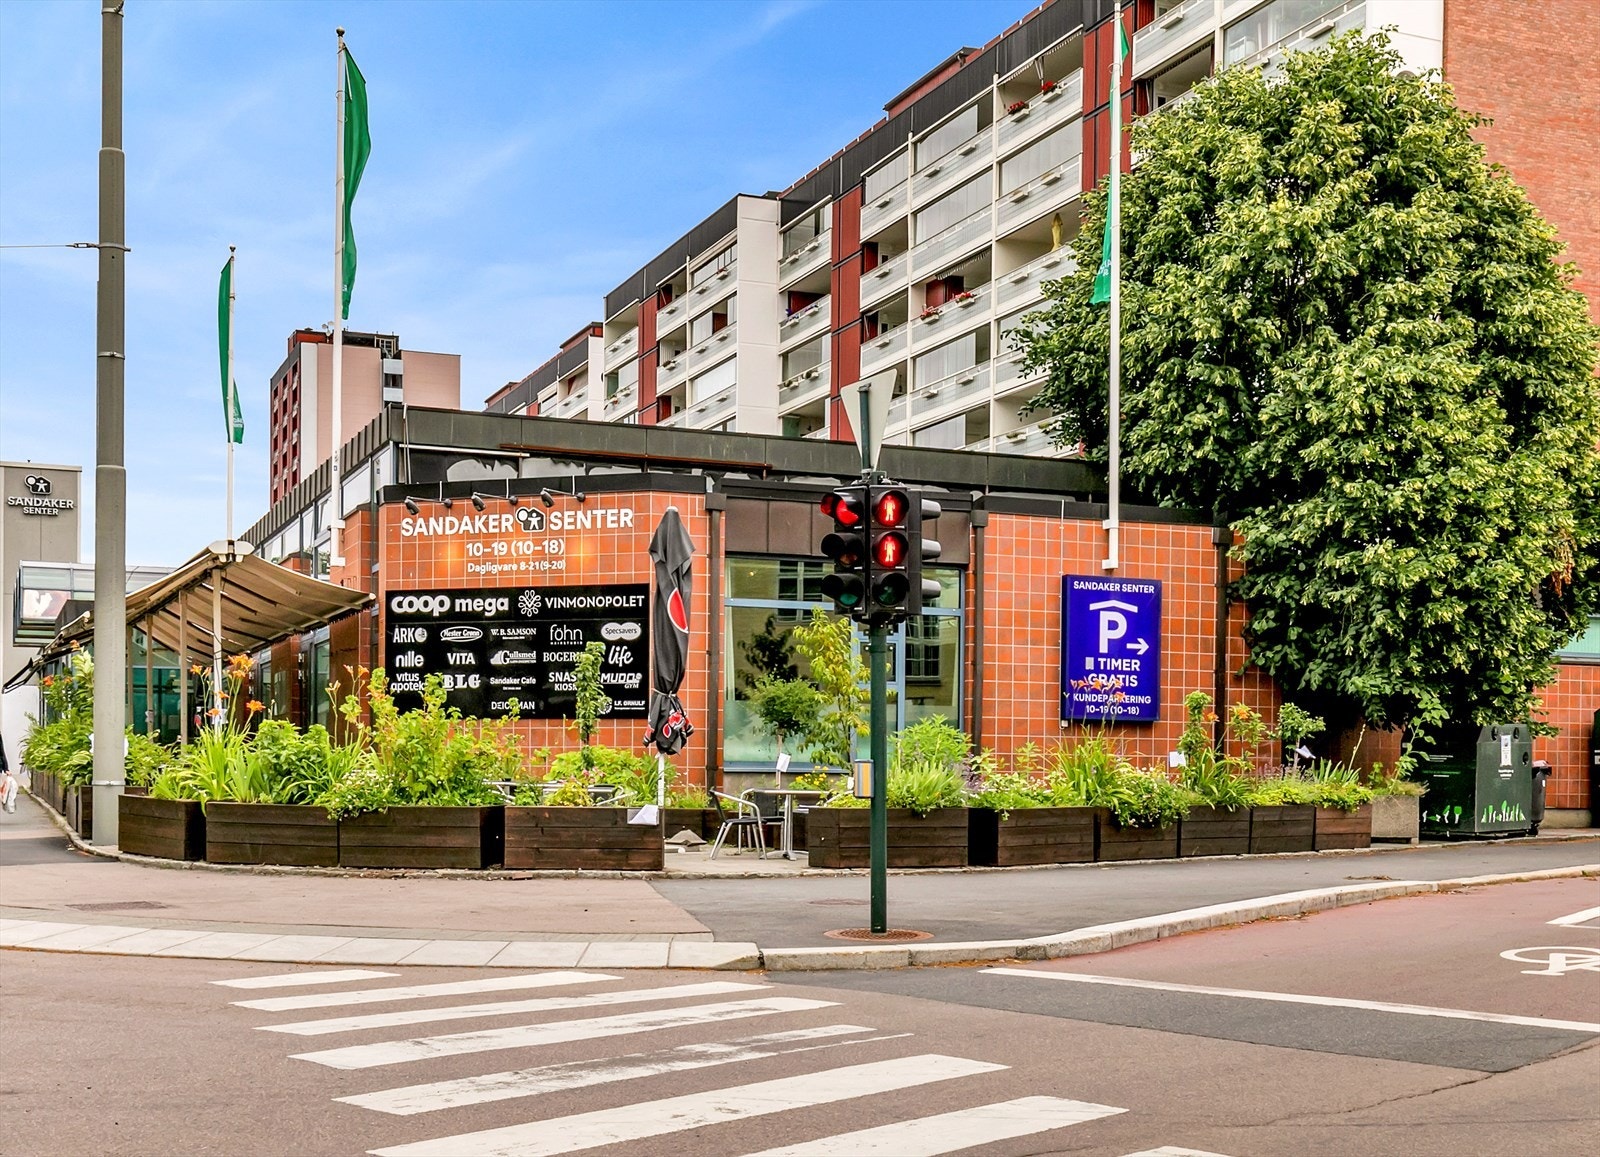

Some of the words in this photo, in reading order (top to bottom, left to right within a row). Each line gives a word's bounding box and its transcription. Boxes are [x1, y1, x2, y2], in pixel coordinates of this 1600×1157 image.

[8, 496, 74, 509] SANDAKER
[23, 506, 59, 515] SENTER
[401, 513, 514, 537] SANDAKER
[549, 508, 634, 531] SENTER
[465, 541, 507, 557] 10-19
[510, 538, 565, 557] (10-18)
[467, 561, 518, 574] Dagligvare
[1073, 581, 1121, 592] SANDAKER
[1121, 583, 1155, 594] SENTER
[391, 595, 451, 617] coop
[454, 597, 509, 617] mega
[544, 595, 645, 609] VINMONOPOLET
[550, 624, 583, 641] föhn
[605, 627, 638, 636] Specsavers
[1098, 610, 1128, 654] P
[395, 650, 425, 668] nille
[447, 652, 476, 665] VITA
[608, 645, 634, 667] life
[1097, 657, 1141, 672] TIMER
[396, 672, 420, 682] vitus
[490, 676, 521, 685] Sandaker
[521, 676, 537, 685] Cafe
[1087, 673, 1139, 688] GRATIS
[491, 701, 536, 710] DEICAN
